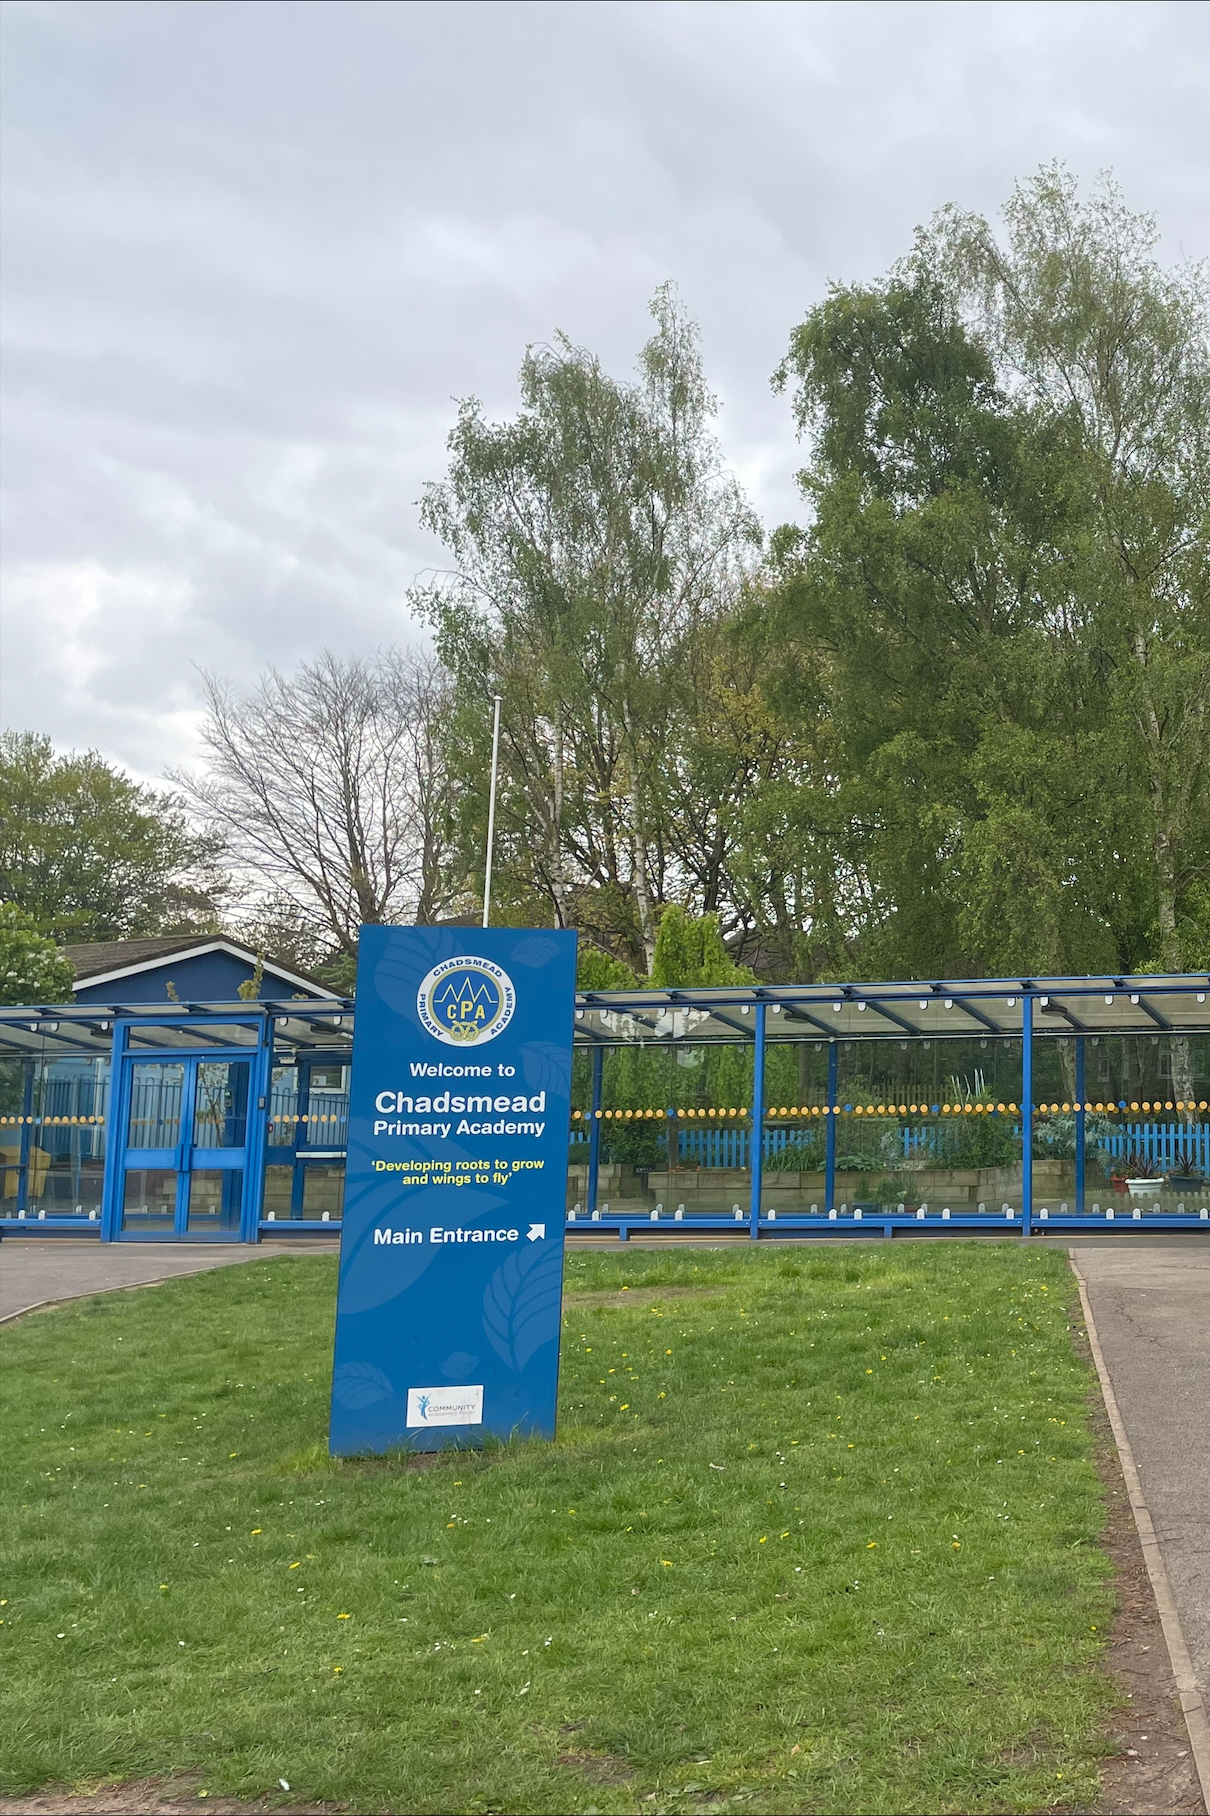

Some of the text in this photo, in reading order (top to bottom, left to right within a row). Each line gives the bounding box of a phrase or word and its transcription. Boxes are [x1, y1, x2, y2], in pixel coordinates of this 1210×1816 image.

[433, 959, 502, 978] CHADSMEAD
[419, 993, 444, 1037] PRIMARY
[446, 1000, 486, 1020] CPA
[490, 986, 513, 1036] ACADEMY
[409, 1063, 516, 1077] Welcome to
[375, 1091, 546, 1114] Chadsmead
[373, 1119, 545, 1138] Primary Academy
[455, 1160, 490, 1171] roots
[494, 1159, 508, 1170] to
[512, 1160, 544, 1172] grow
[402, 1174, 428, 1185] and
[432, 1173, 471, 1186] wings
[475, 1173, 489, 1184] to
[373, 1227, 519, 1245] Main Entrance
[428, 1404, 476, 1412] COMMUNITY
